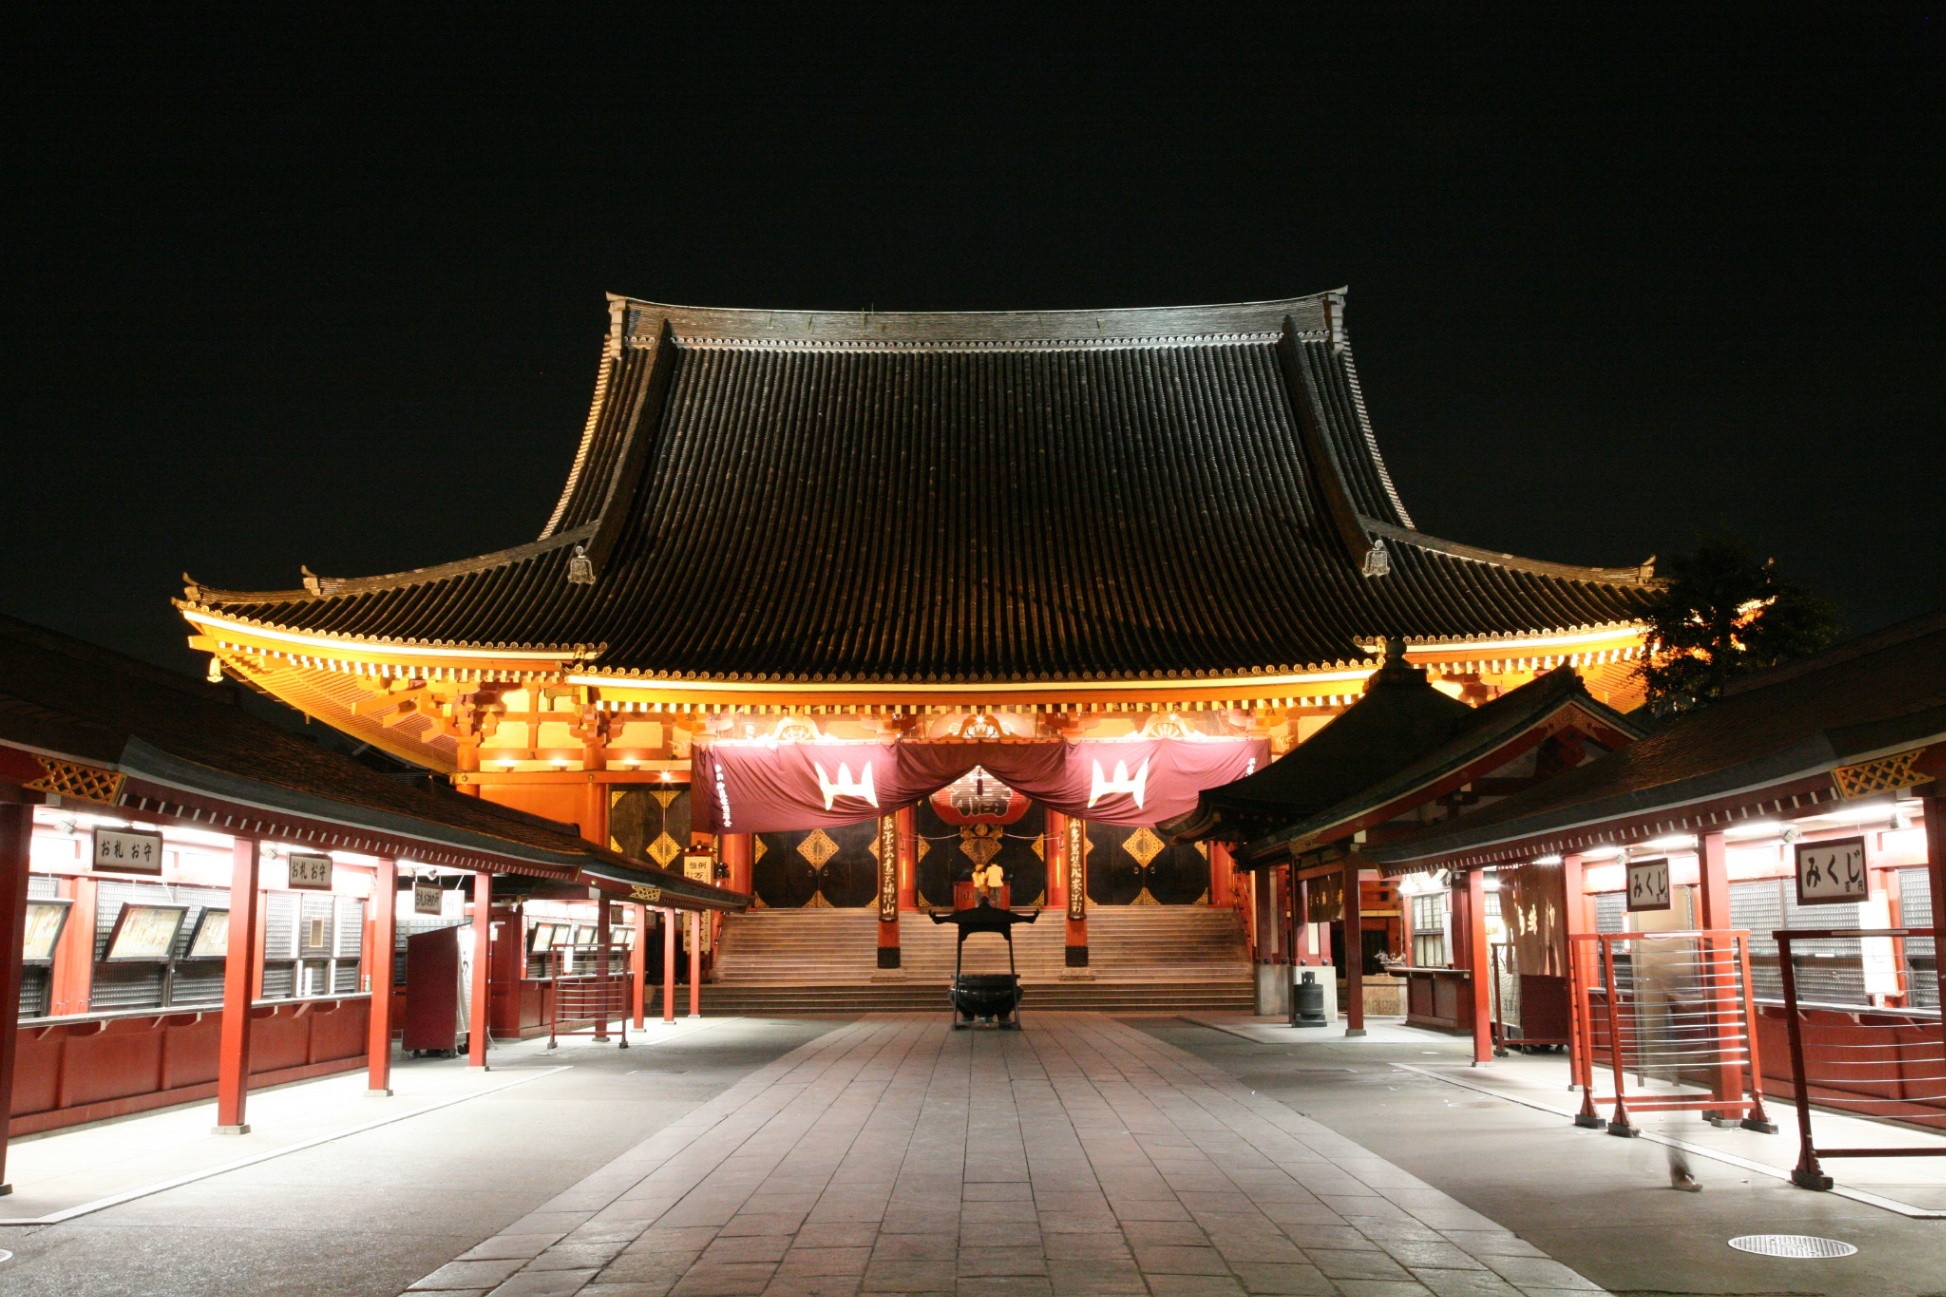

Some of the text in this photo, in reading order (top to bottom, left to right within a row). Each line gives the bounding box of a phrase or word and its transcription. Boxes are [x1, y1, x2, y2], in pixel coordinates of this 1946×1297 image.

[1633, 868, 1666, 898] みくじ
[1806, 849, 1861, 888] みくじ
